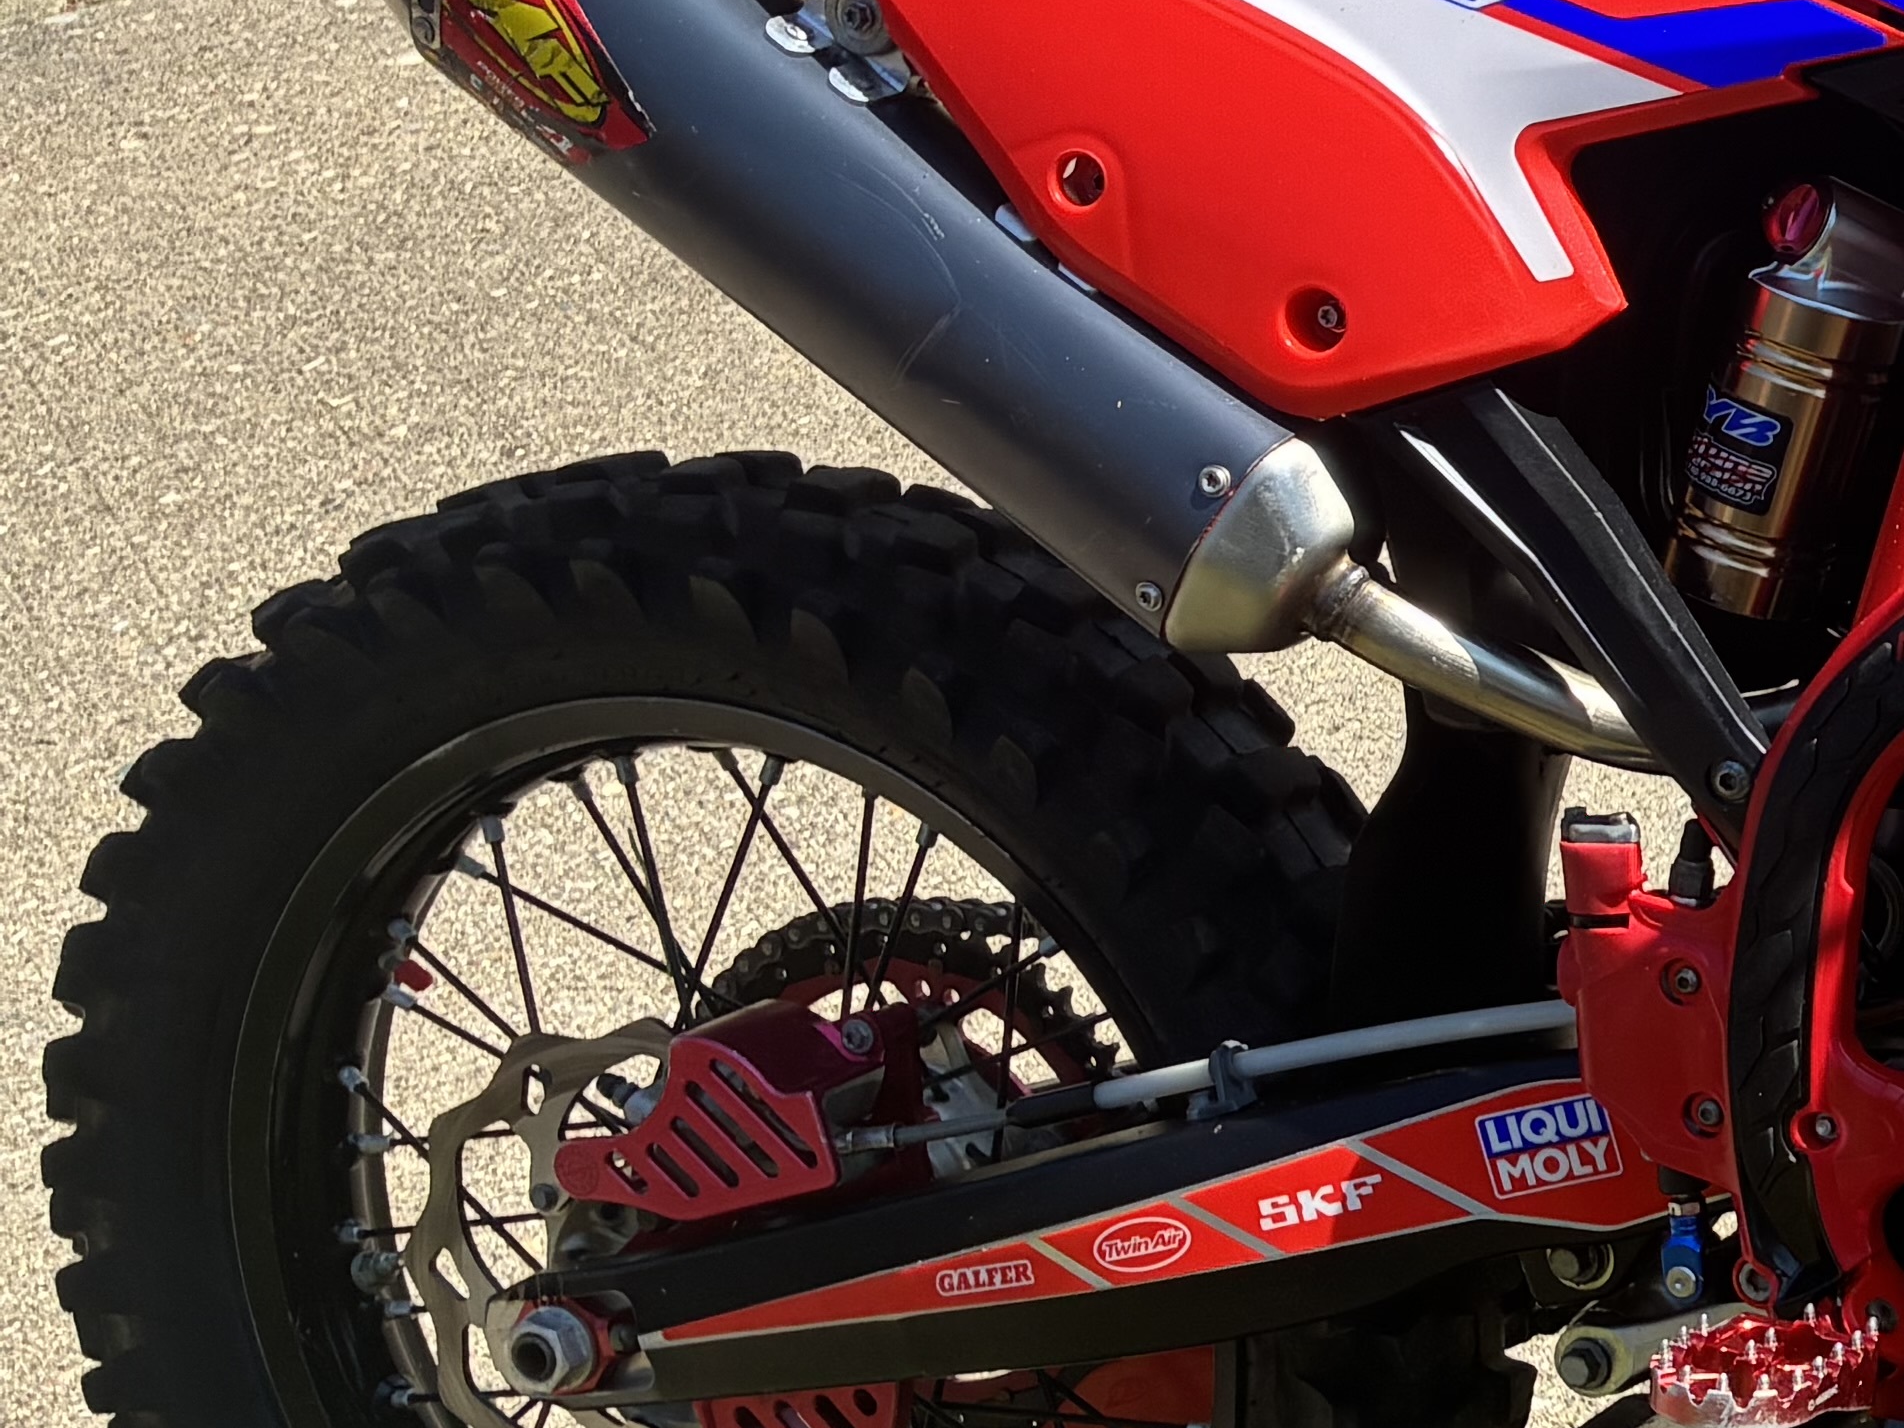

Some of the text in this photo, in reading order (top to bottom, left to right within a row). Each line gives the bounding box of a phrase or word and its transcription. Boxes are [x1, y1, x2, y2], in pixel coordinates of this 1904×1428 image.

[1483, 1097, 1604, 1156] LIQUI
[1495, 1137, 1611, 1193] MOLY
[1257, 1174, 1383, 1231] SKF
[1102, 1228, 1183, 1260] Twin Air
[937, 1262, 1033, 1294] GALFER
